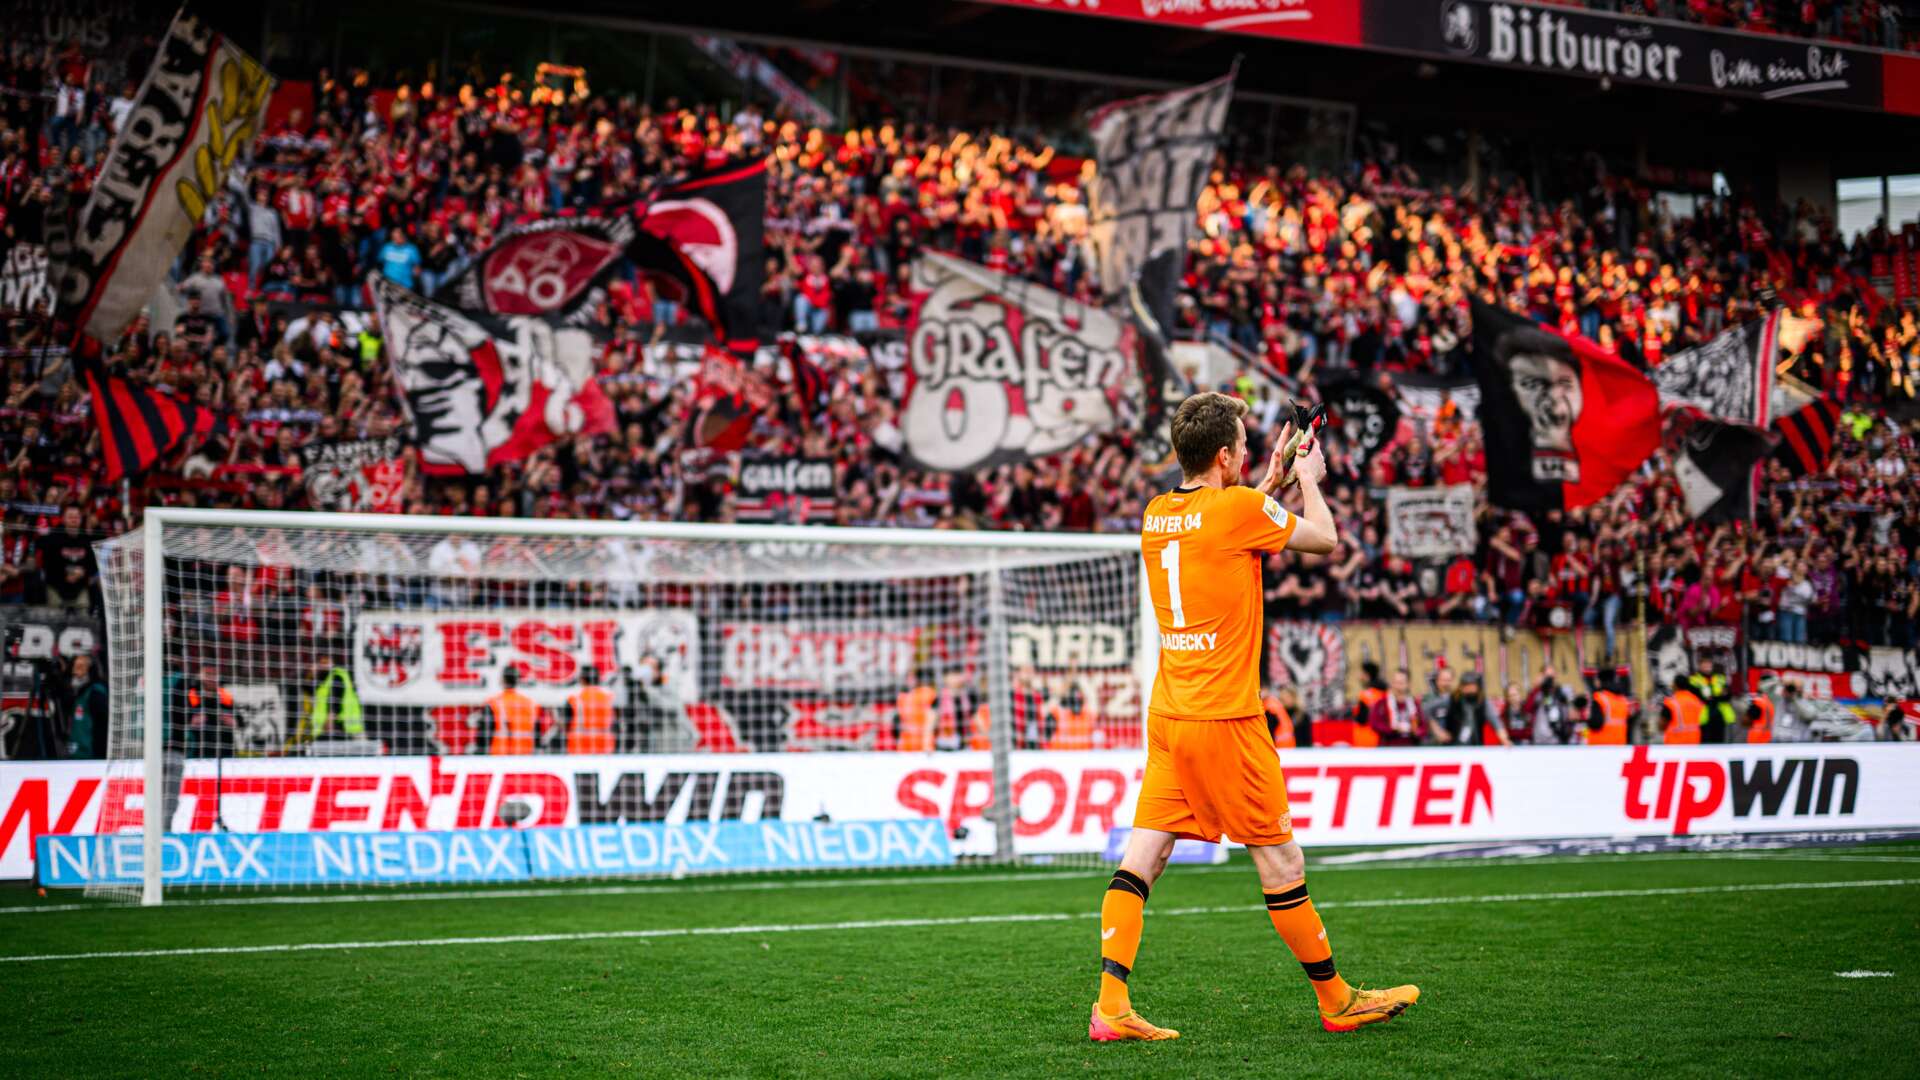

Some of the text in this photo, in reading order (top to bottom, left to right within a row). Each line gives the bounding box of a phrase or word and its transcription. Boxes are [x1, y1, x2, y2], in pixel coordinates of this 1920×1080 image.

[1487, 3, 1682, 82] Bitburger
[1710, 48, 1763, 88] Bitte
[1808, 46, 1849, 80] Bit
[1144, 512, 1202, 533] BAYER 04
[1161, 540, 1186, 628] 1
[47, 836, 271, 880] NIEDAX
[311, 832, 519, 878] NIEDAX
[533, 825, 731, 874] NIEDAX
[760, 820, 944, 865] NIEDAX
